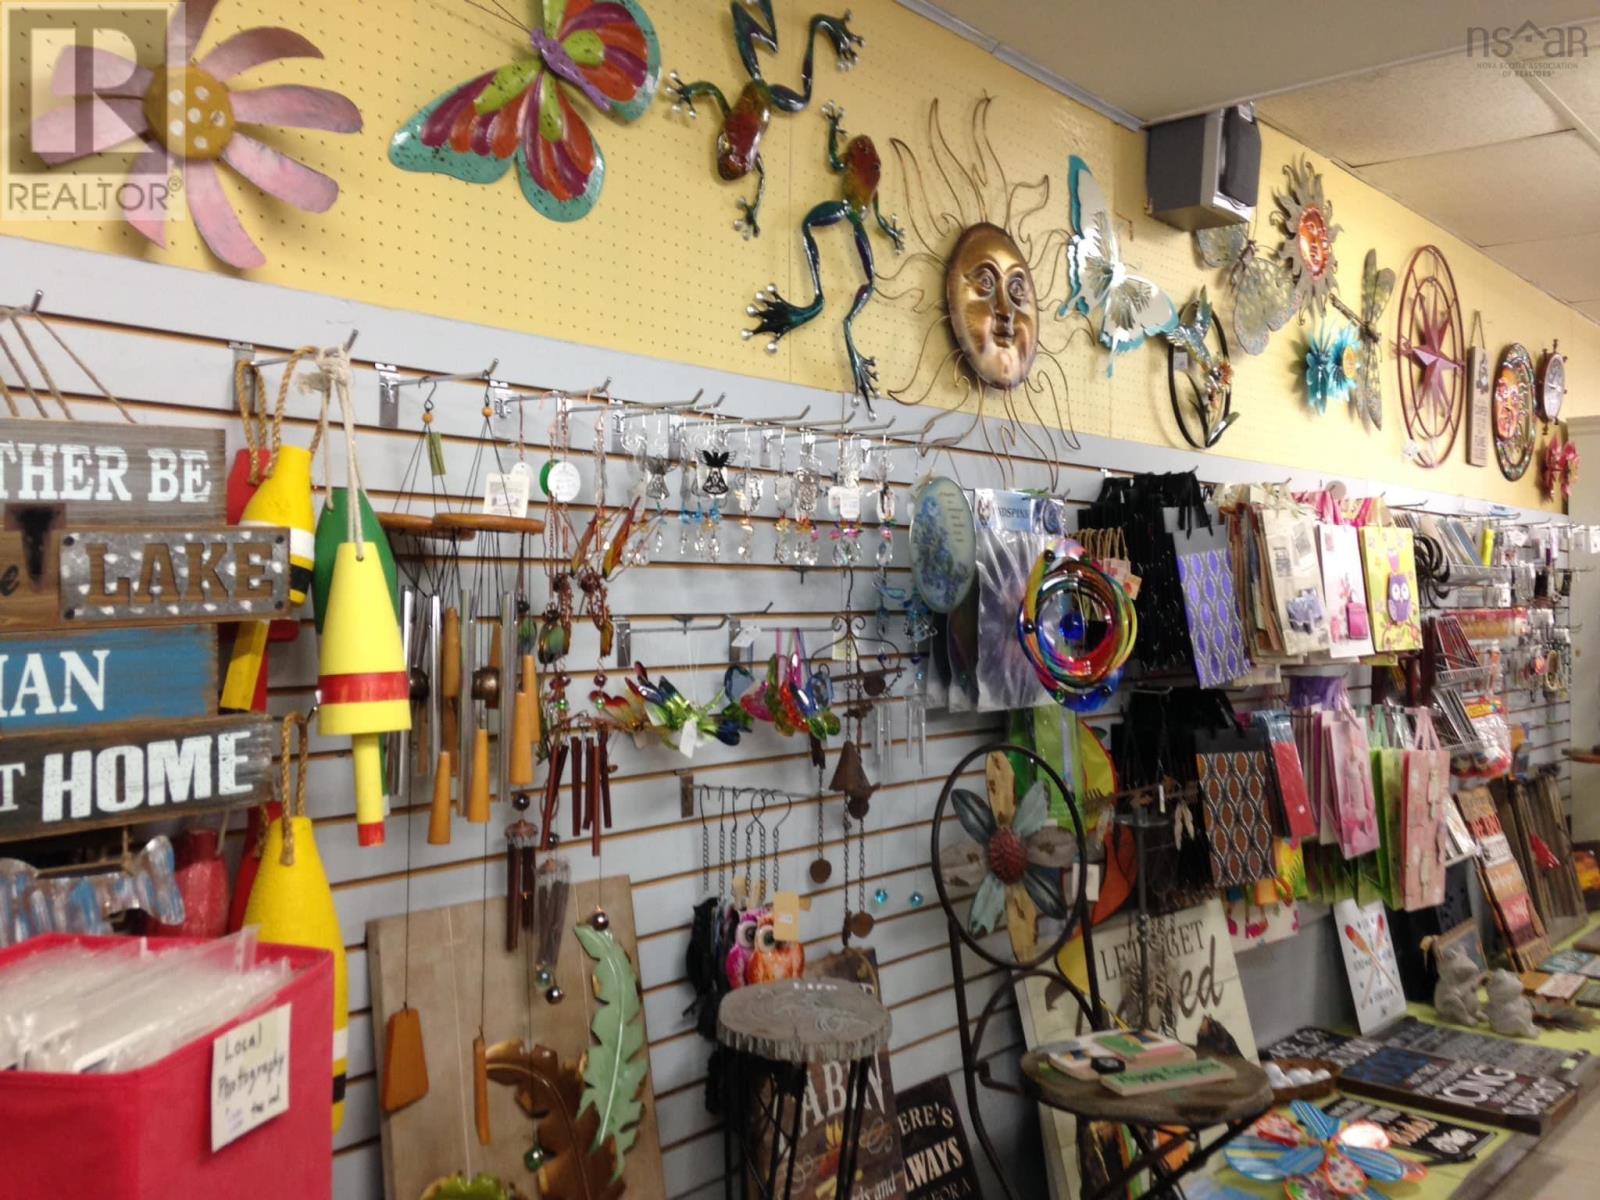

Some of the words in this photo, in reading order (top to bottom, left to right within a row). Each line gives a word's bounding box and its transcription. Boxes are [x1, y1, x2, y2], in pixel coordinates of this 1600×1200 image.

[147, 449, 212, 503] BE
[85, 542, 274, 605] LAKE
[0, 650, 111, 718] AN
[42, 731, 254, 822] HOME
[1165, 919, 1205, 959] GET
[224, 1020, 262, 1062] Local
